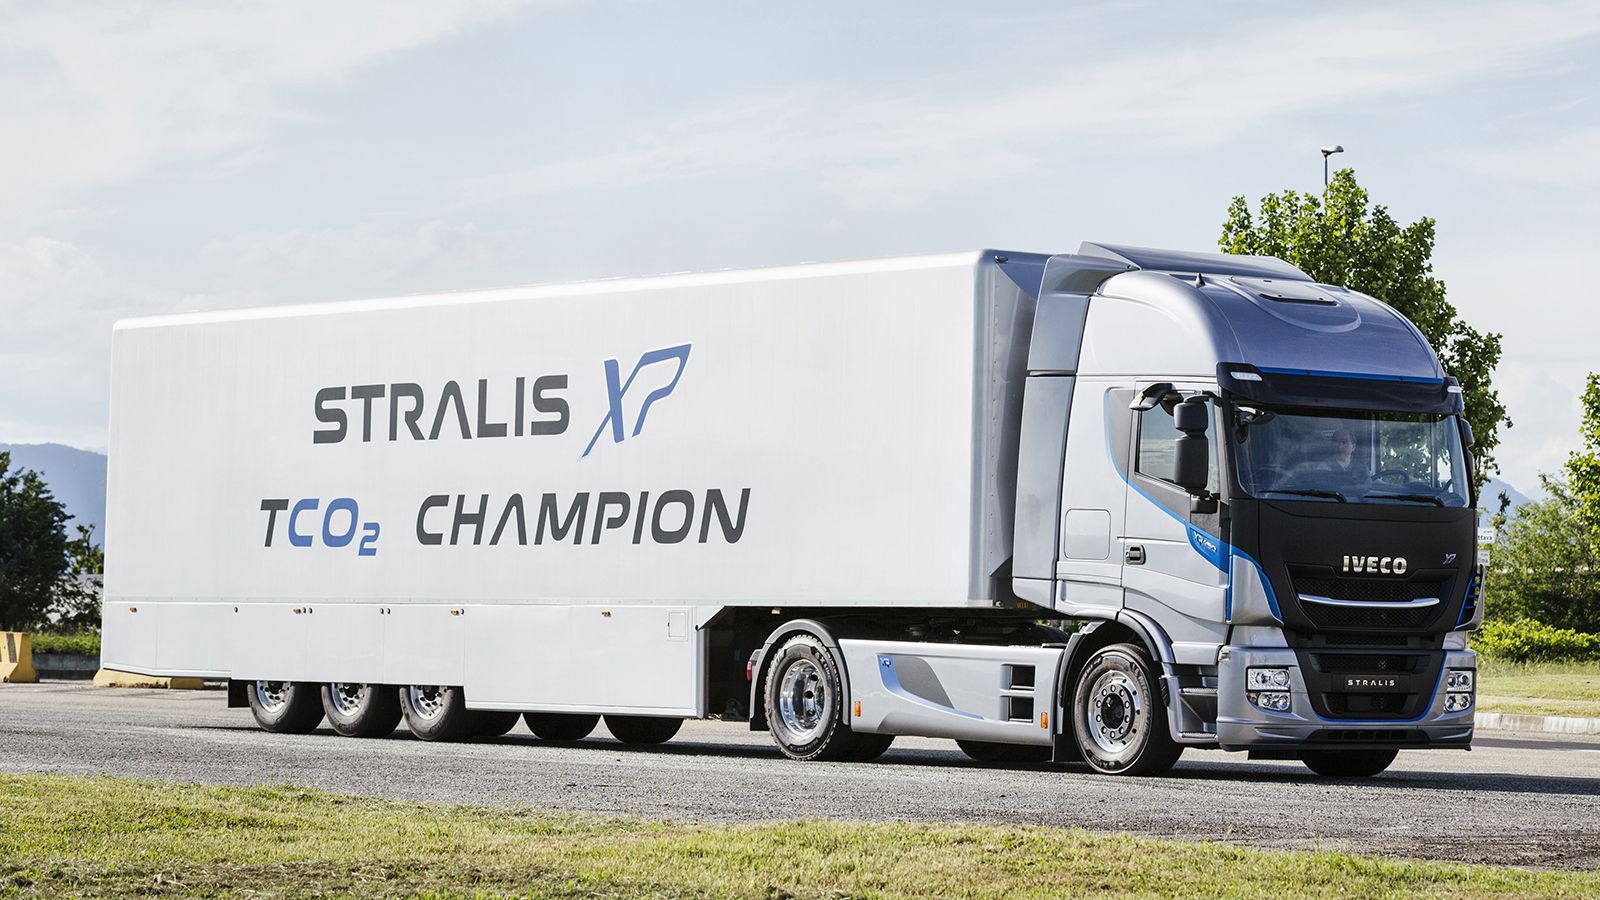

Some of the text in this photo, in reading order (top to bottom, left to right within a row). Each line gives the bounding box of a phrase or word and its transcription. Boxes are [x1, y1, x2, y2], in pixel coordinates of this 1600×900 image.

[313, 343, 692, 461] STRALIS XP
[416, 488, 751, 546] CHAMPION
[1343, 555, 1407, 575] IVECO
[1347, 679, 1395, 687] STRALIS
